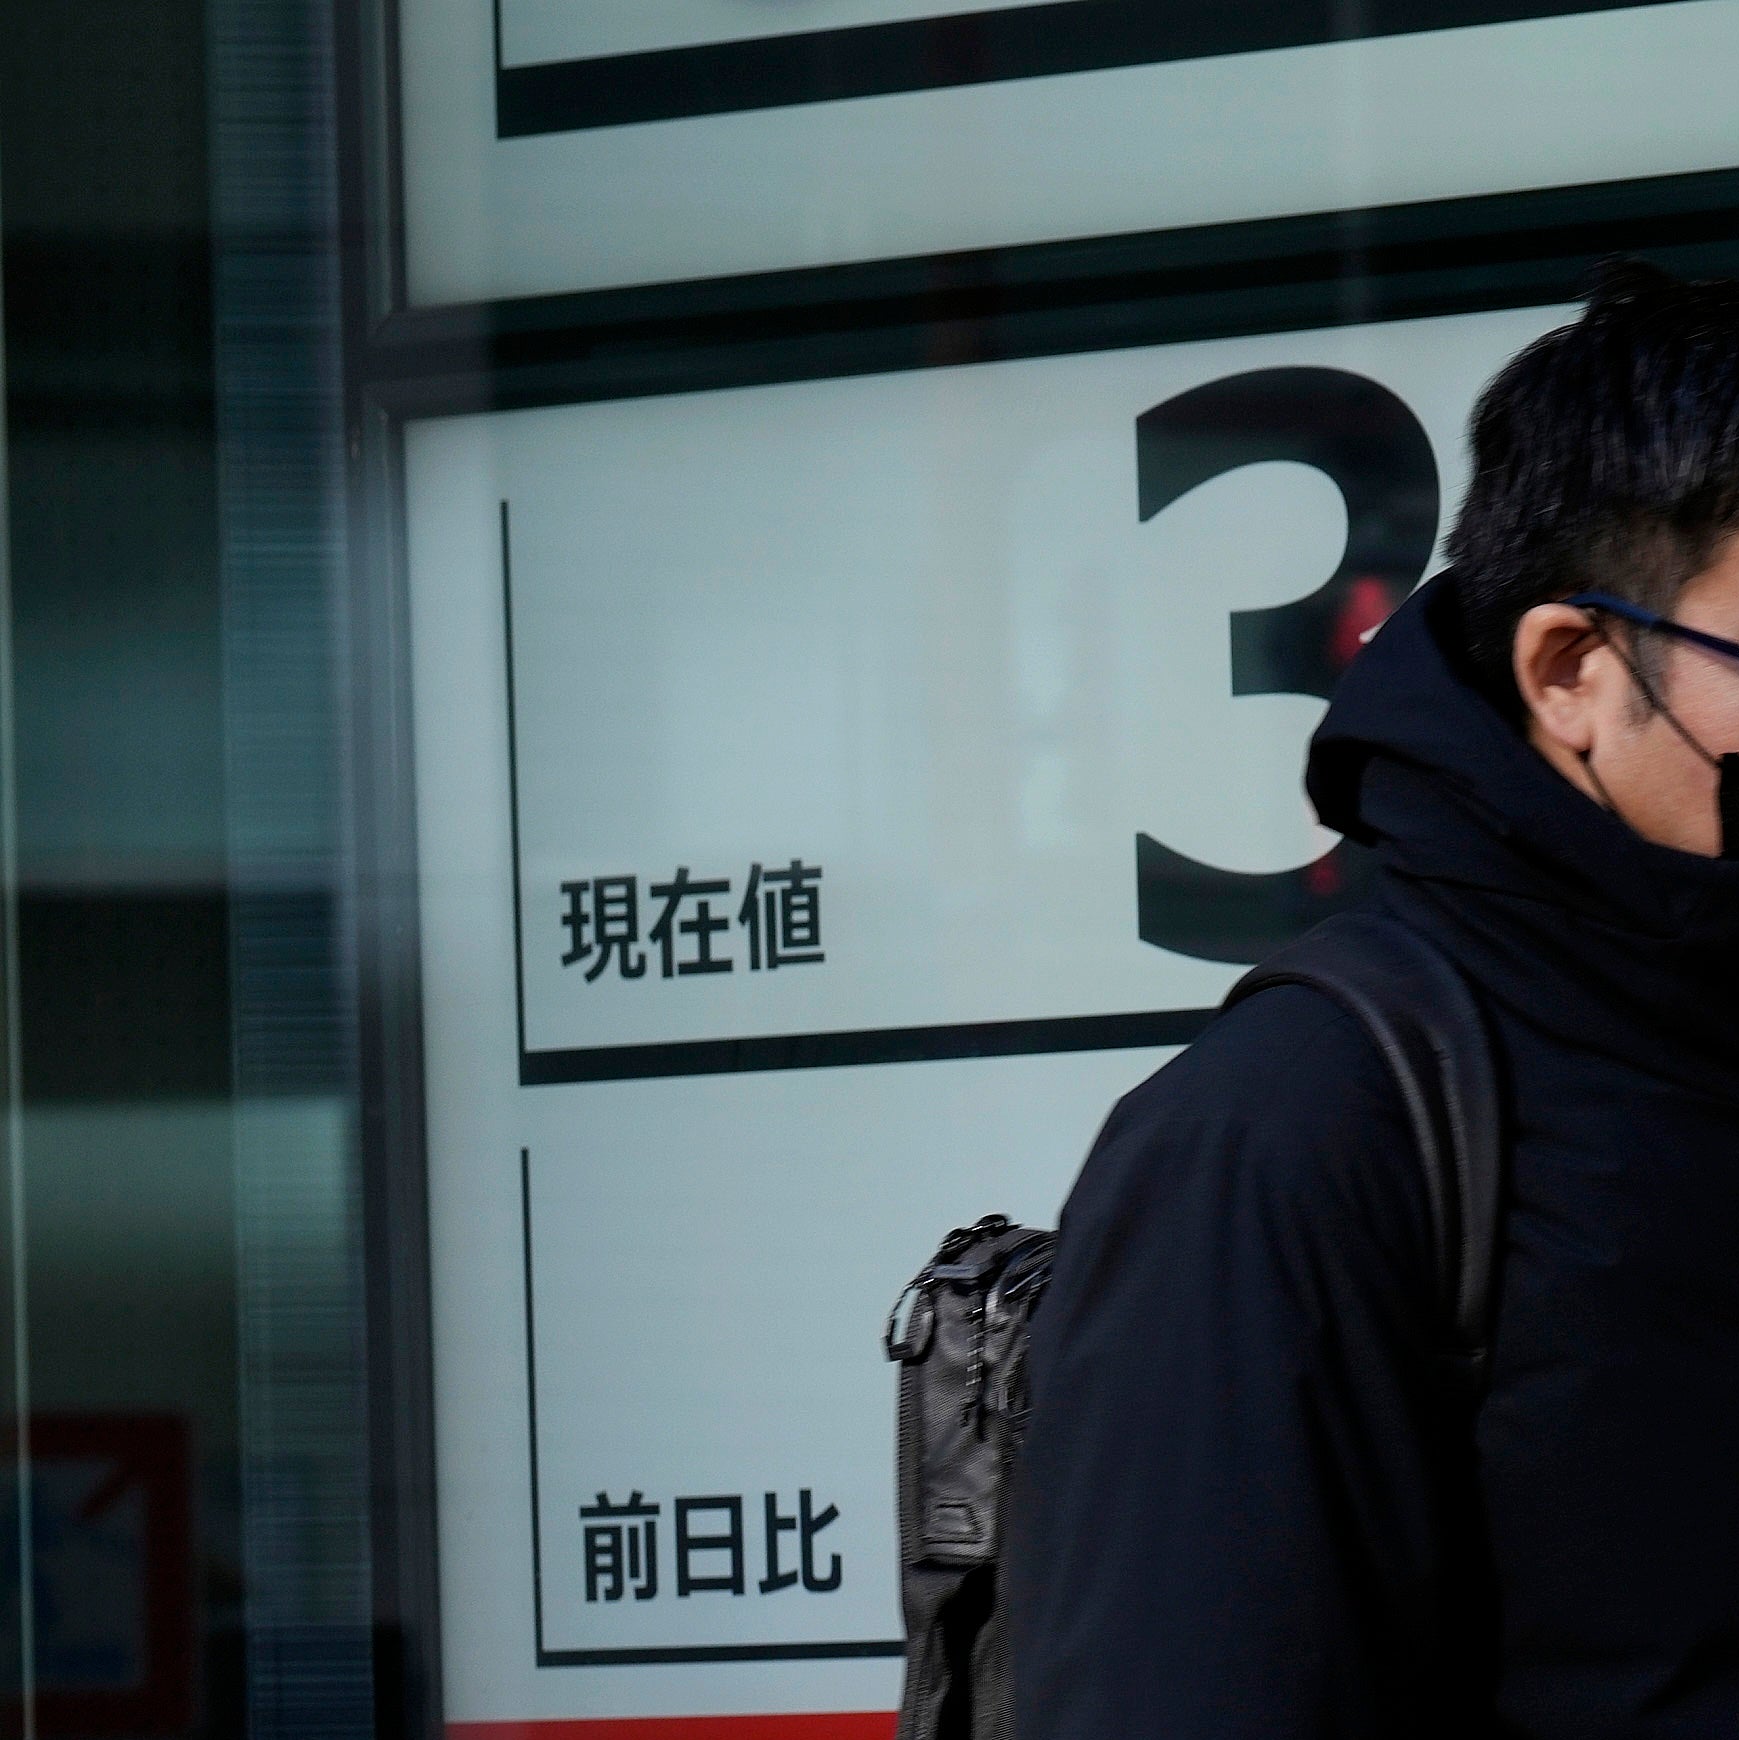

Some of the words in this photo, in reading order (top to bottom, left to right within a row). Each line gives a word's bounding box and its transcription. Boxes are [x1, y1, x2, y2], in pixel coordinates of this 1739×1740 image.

[559, 859, 826, 983] 現在値
[579, 1489, 842, 1603] 前日比
